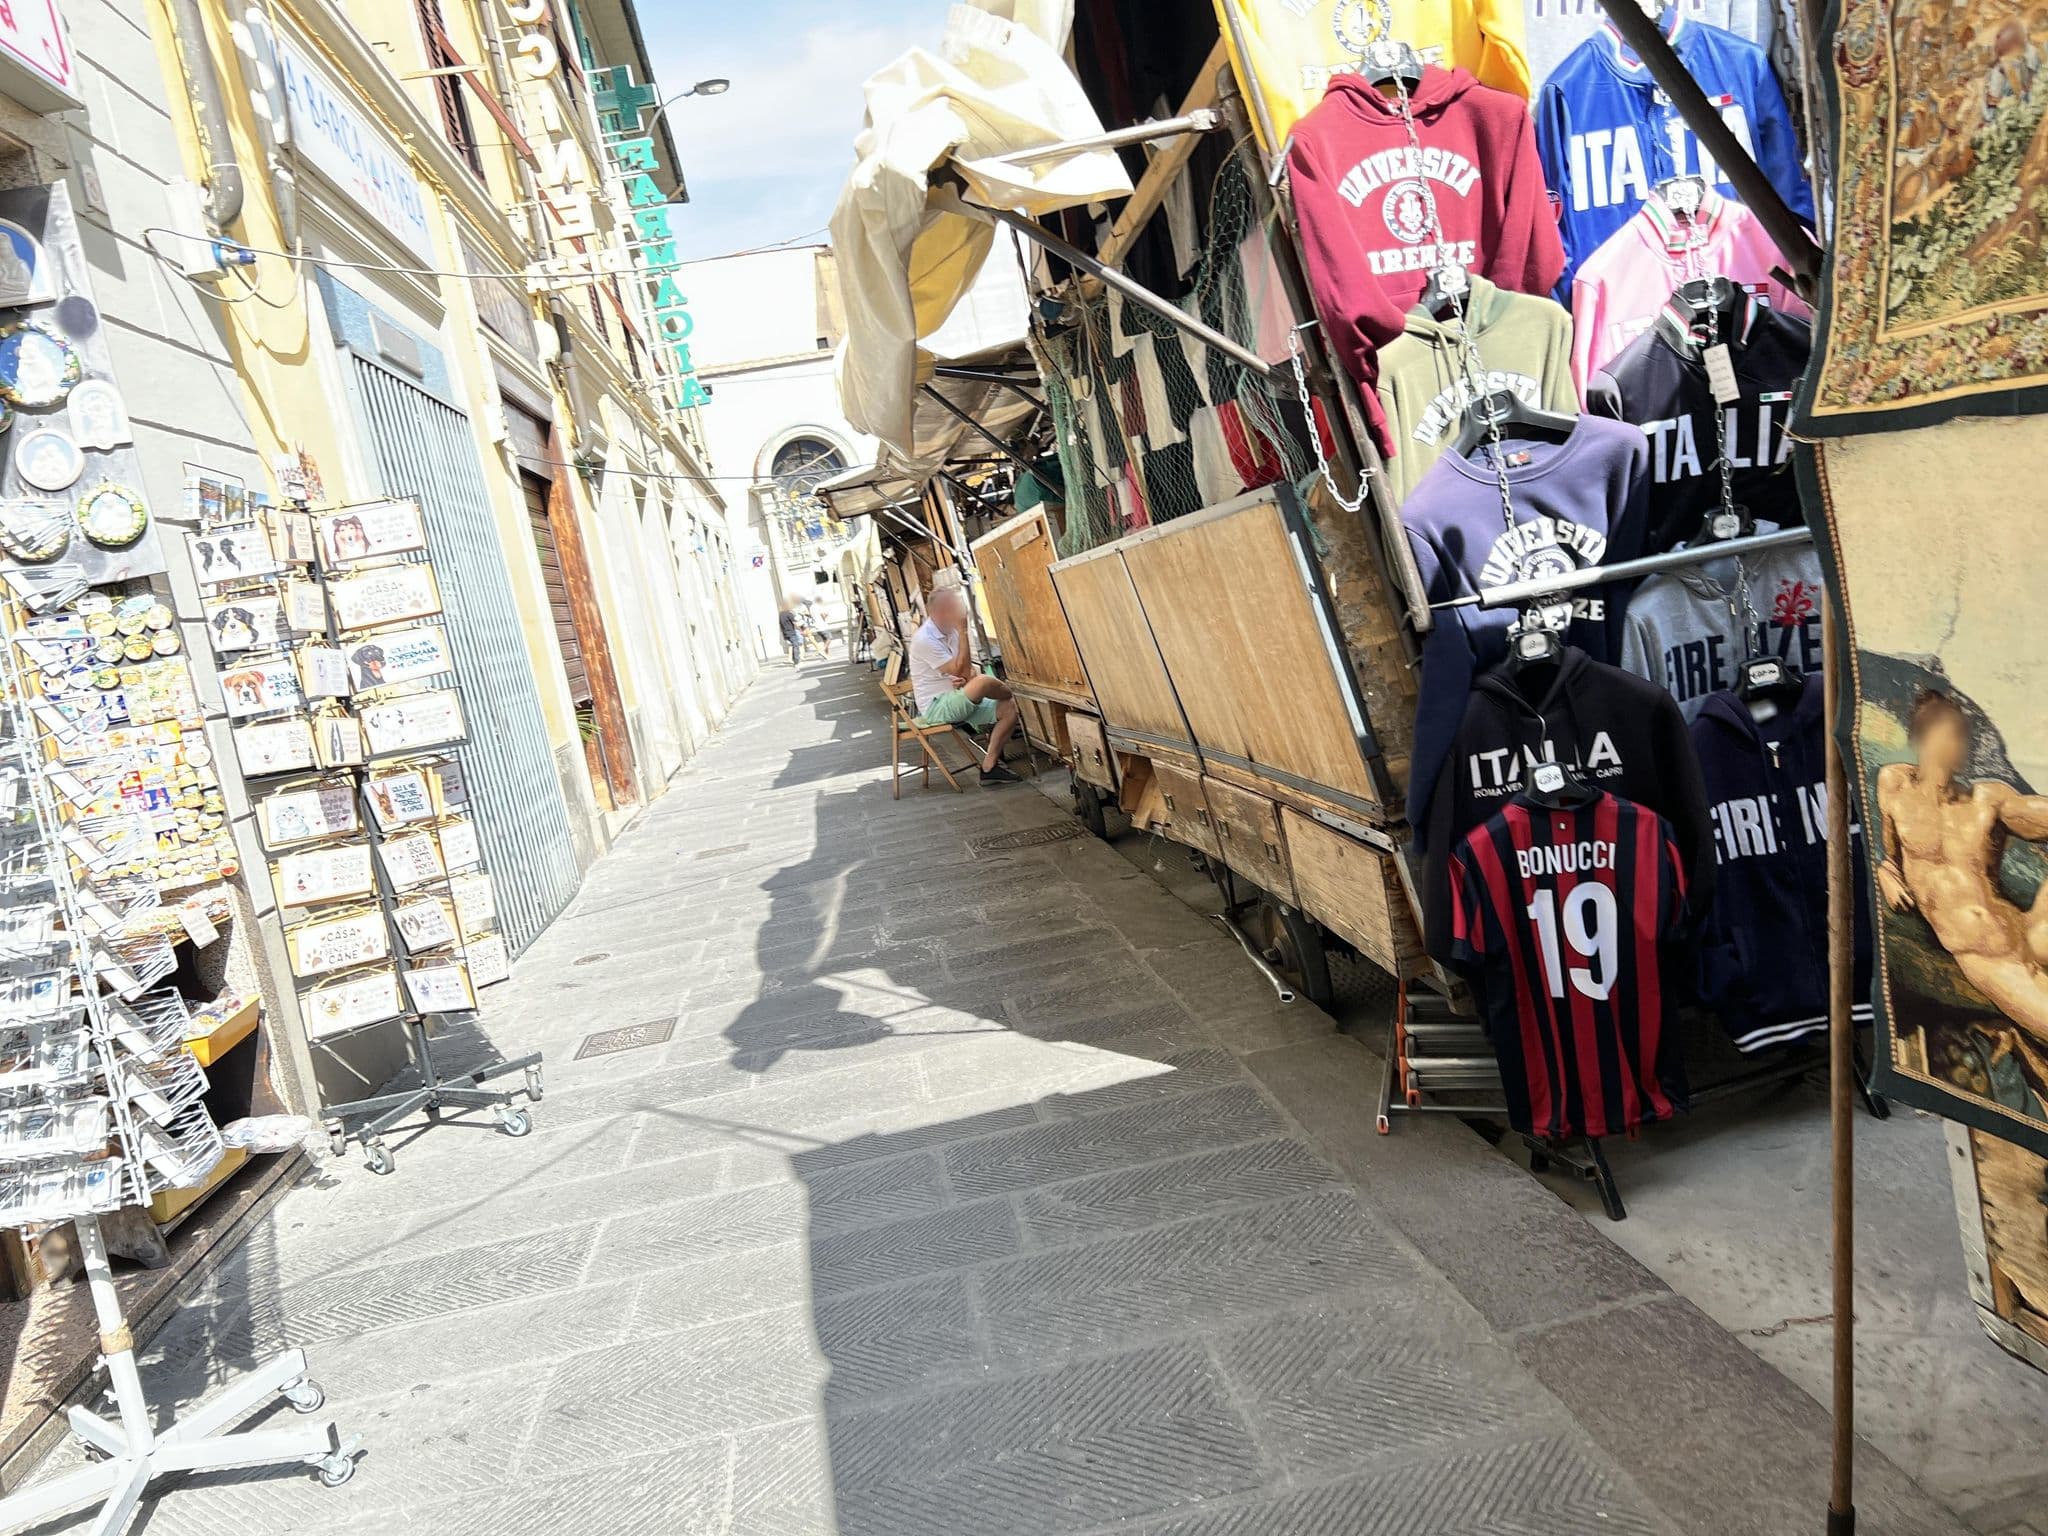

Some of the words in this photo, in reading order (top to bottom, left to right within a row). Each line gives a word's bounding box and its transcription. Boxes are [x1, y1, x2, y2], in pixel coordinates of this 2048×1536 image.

[1640, 404, 1794, 484] TALI
[1469, 731, 1623, 789] ITALA
[1516, 841, 1616, 878] BONUCCI
[327, 928, 357, 942] CASA
[328, 950, 359, 965] CANE
[1527, 881, 1618, 1001] 19
